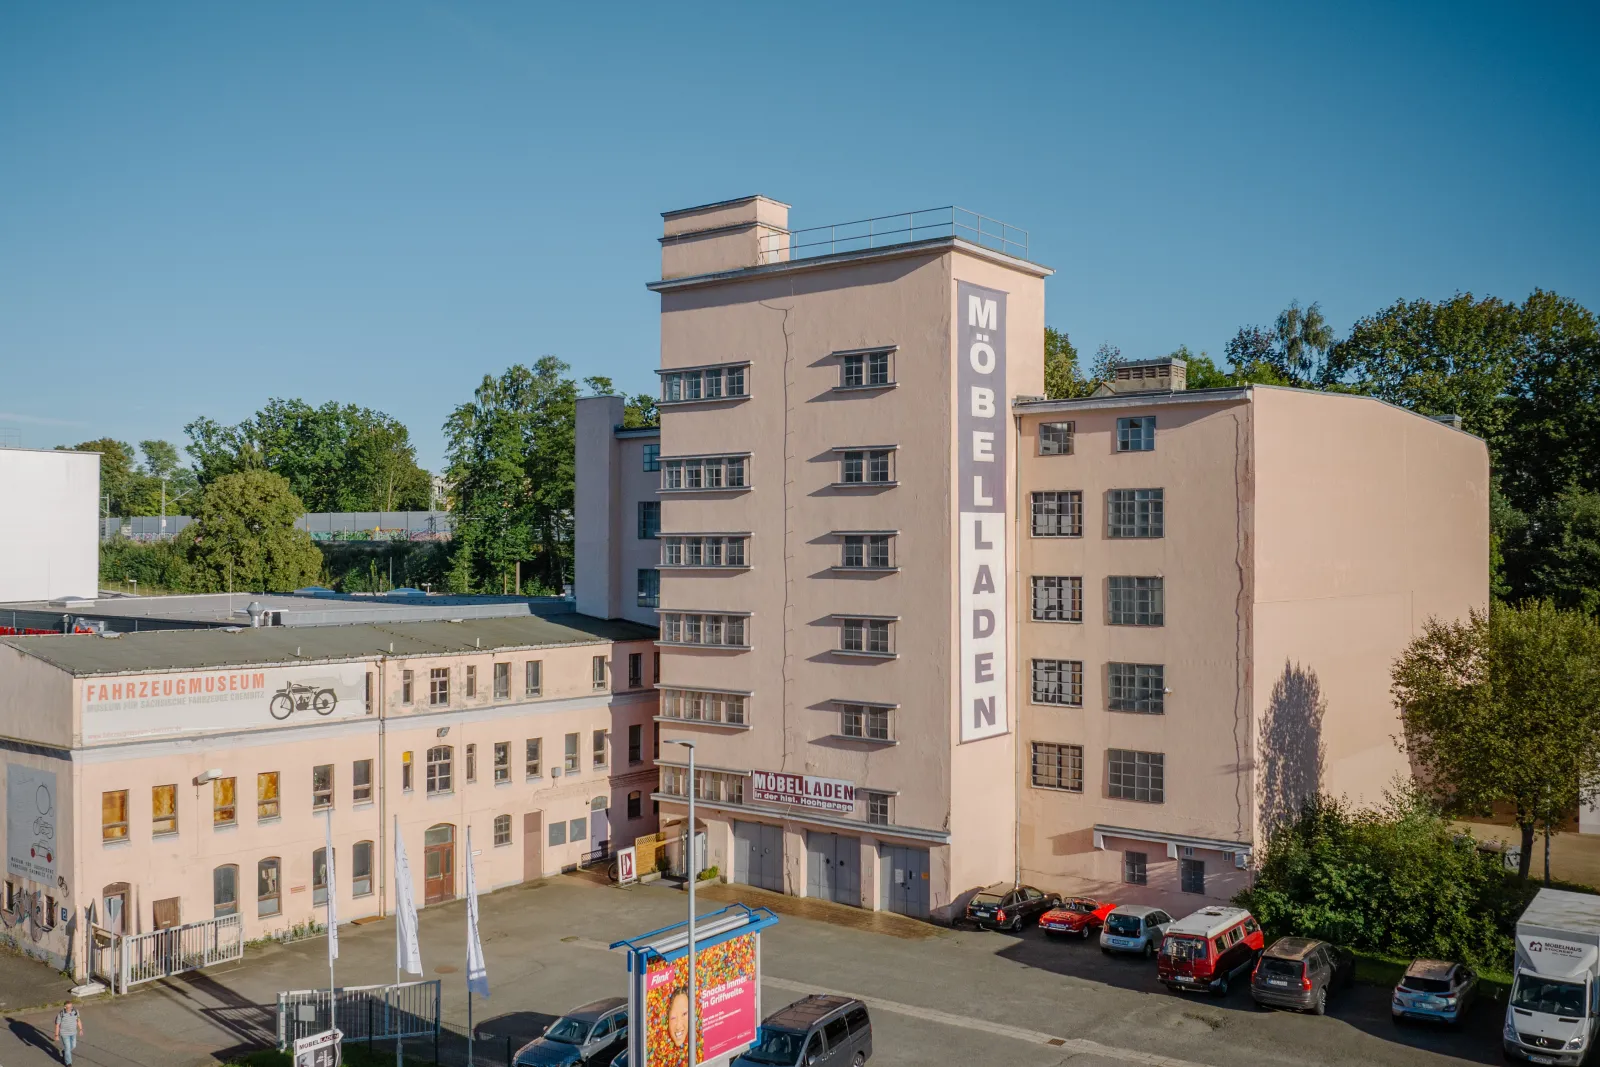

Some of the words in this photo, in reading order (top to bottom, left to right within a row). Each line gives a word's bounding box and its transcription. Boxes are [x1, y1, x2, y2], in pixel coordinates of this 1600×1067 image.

[86, 673, 266, 701] FAHRZEUGMUSEUM
[764, 792, 778, 801] der
[800, 797, 853, 811] Hochgarage
[702, 984, 726, 999] Snacks
[702, 1000, 709, 1009] in
